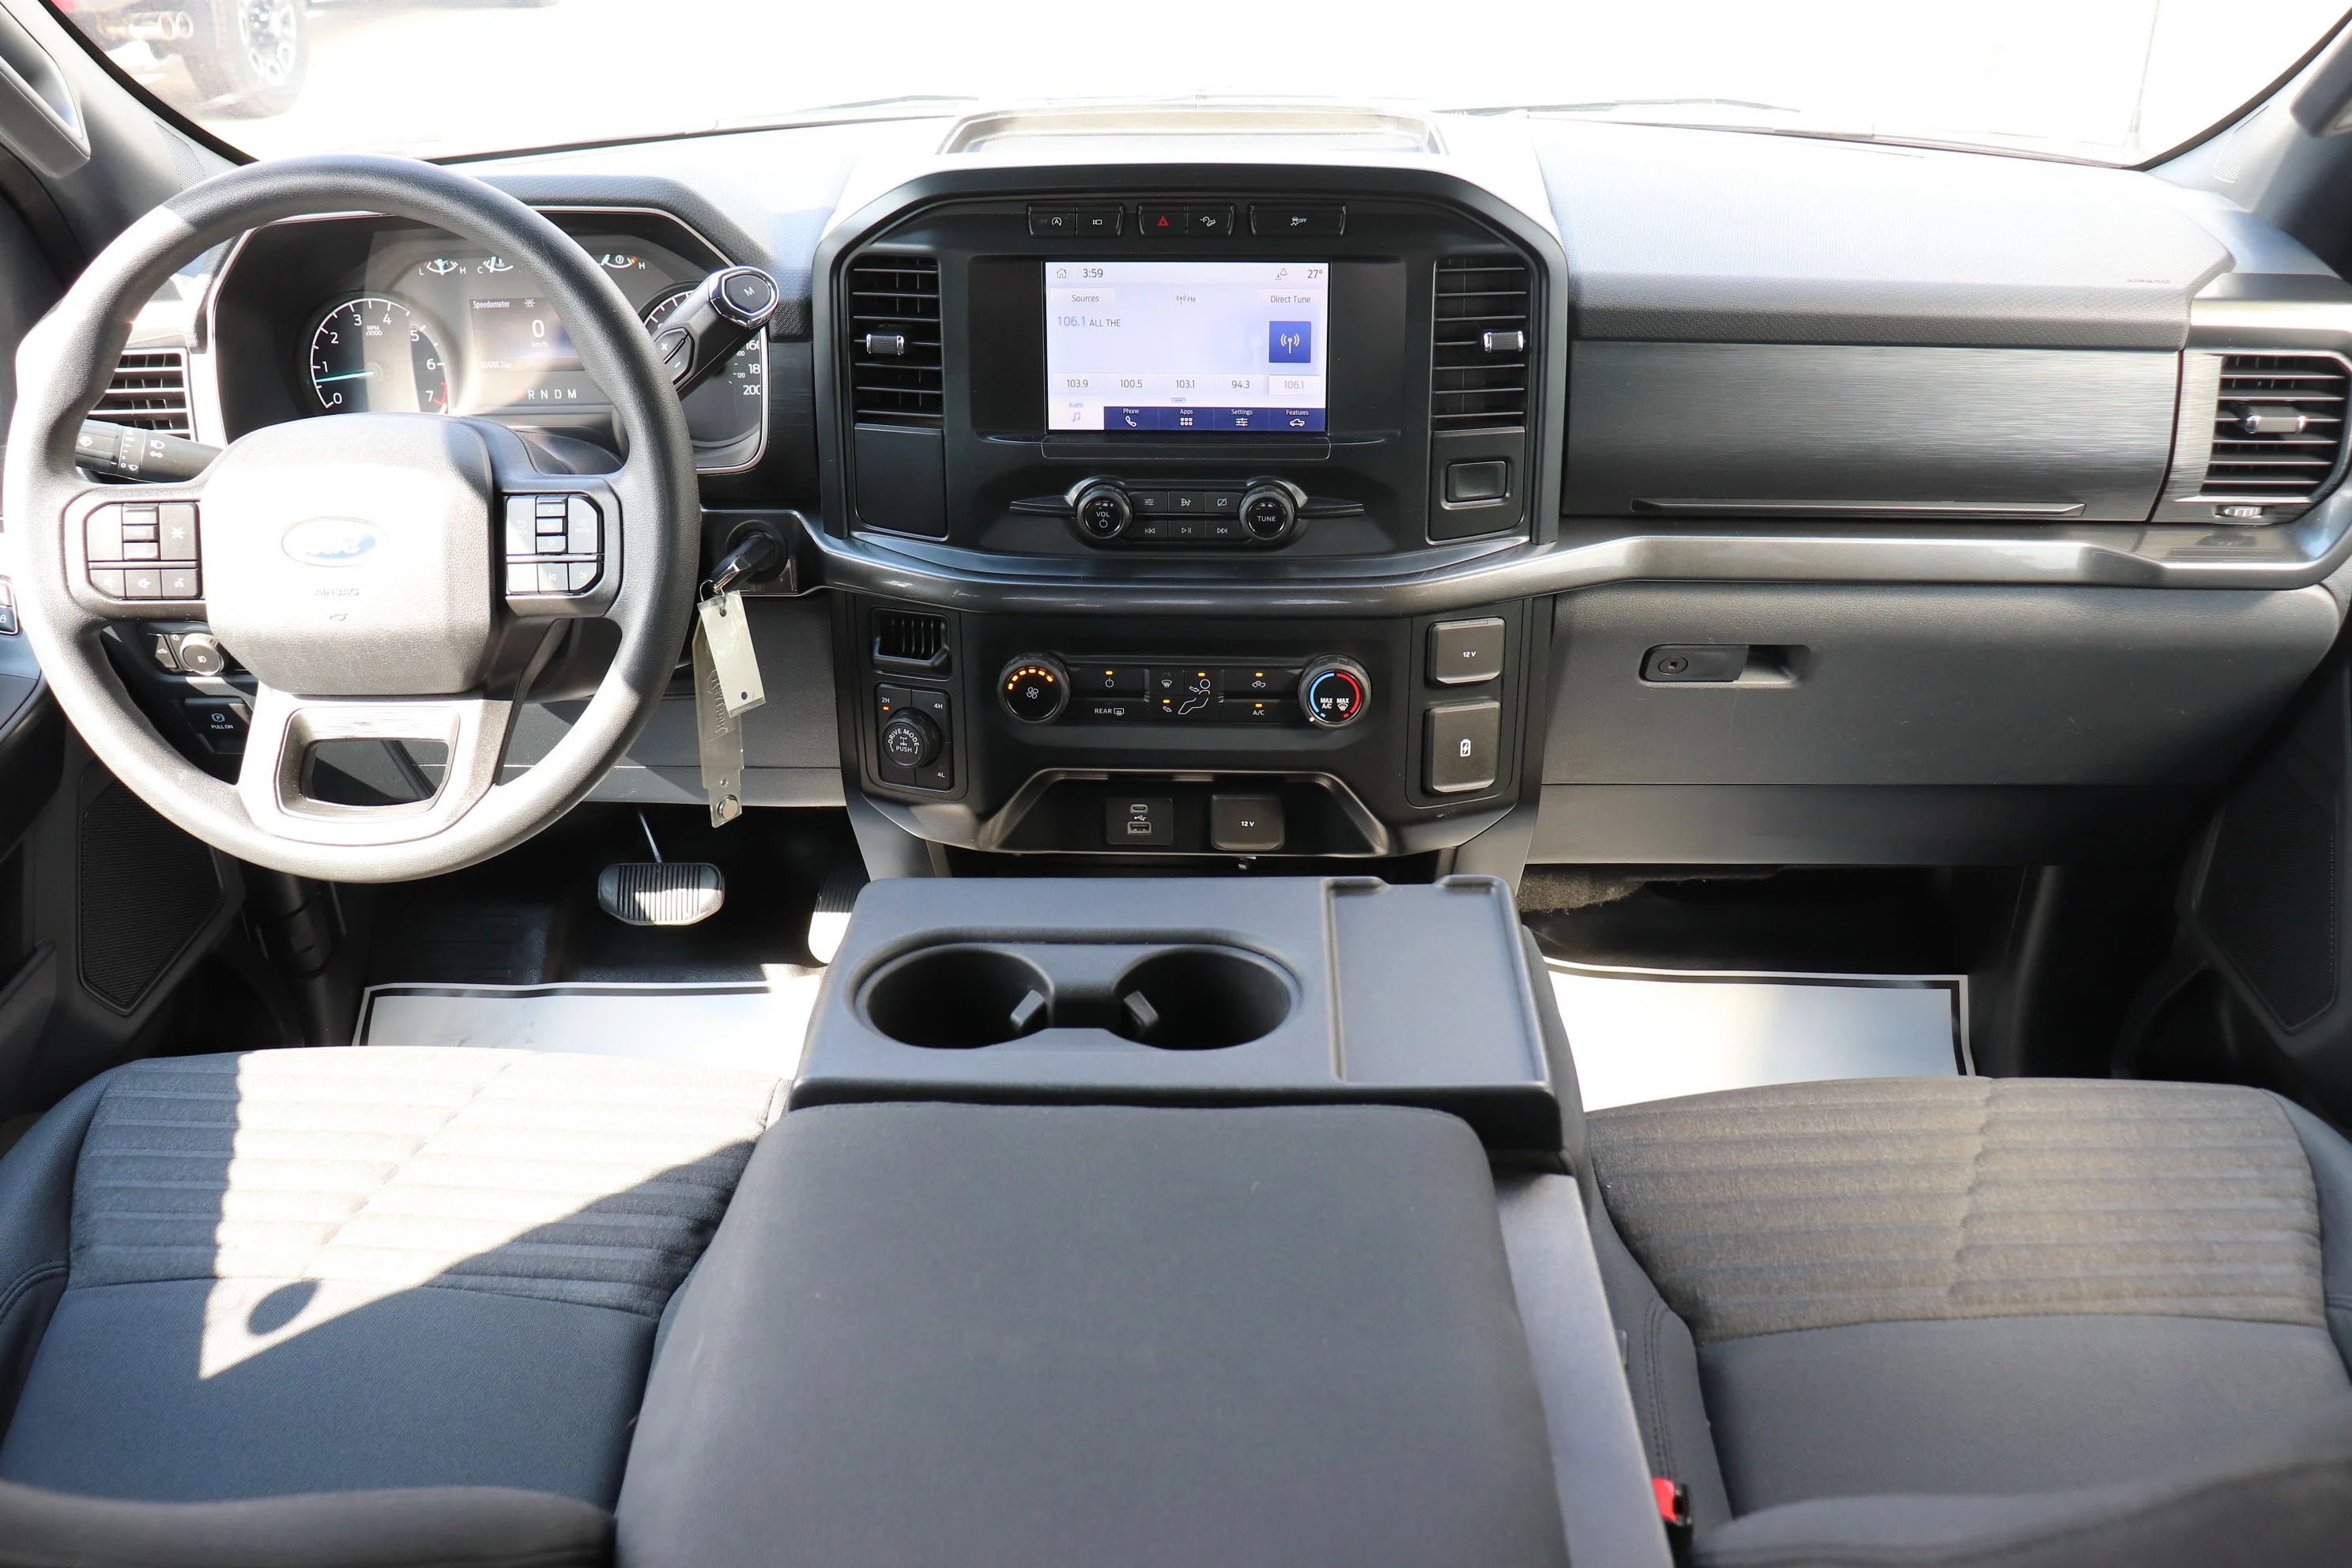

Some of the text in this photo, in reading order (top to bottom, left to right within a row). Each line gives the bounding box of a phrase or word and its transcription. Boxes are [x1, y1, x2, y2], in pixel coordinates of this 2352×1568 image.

[1083, 268, 1104, 278] 3:59
[743, 286, 755, 297] M
[1270, 295, 1291, 303] Direct
[473, 301, 510, 309] Speedometer
[353, 314, 362, 326] 3
[383, 313, 392, 325] 4
[1057, 316, 1086, 326] 106.1
[531, 319, 545, 337] 0
[330, 332, 339, 344] 2
[410, 330, 420, 341] 5
[322, 361, 328, 373] 1
[426, 358, 436, 370] 6
[748, 364, 761, 374] 18
[1067, 379, 1089, 388] 103.9
[1120, 379, 1143, 388] 100.5
[1176, 380, 1195, 389] 103.1
[1231, 380, 1250, 389] 94.3
[1284, 381, 1305, 390] 106.1
[333, 392, 343, 404] 0
[426, 390, 434, 402] 7
[528, 388, 577, 400] R N D M
[888, 728, 920, 747] DRIVE MODE
